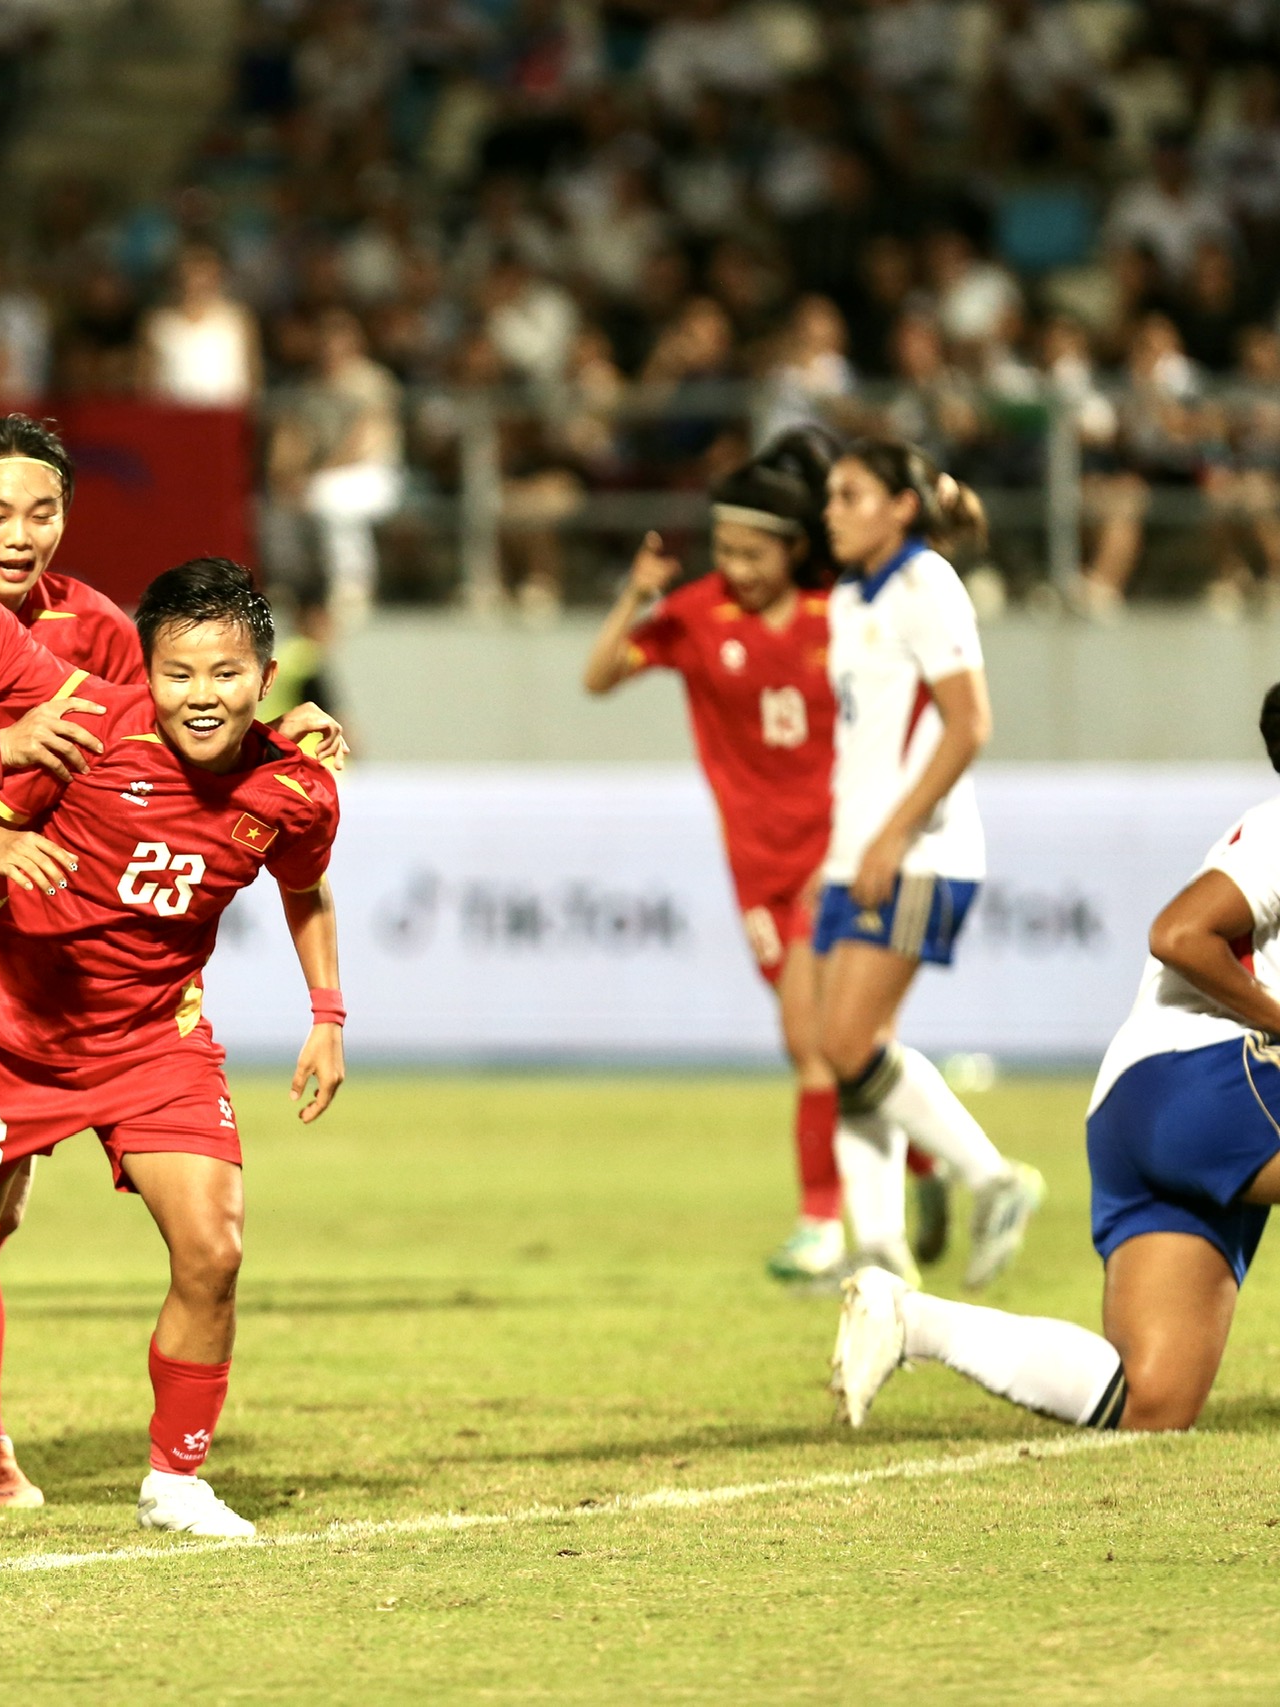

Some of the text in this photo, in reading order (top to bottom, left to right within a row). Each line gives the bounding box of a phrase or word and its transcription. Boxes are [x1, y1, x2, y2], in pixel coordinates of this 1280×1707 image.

[117, 841, 207, 917] 23
[462, 881, 682, 950] TikTok
[982, 882, 1106, 953] Tok
